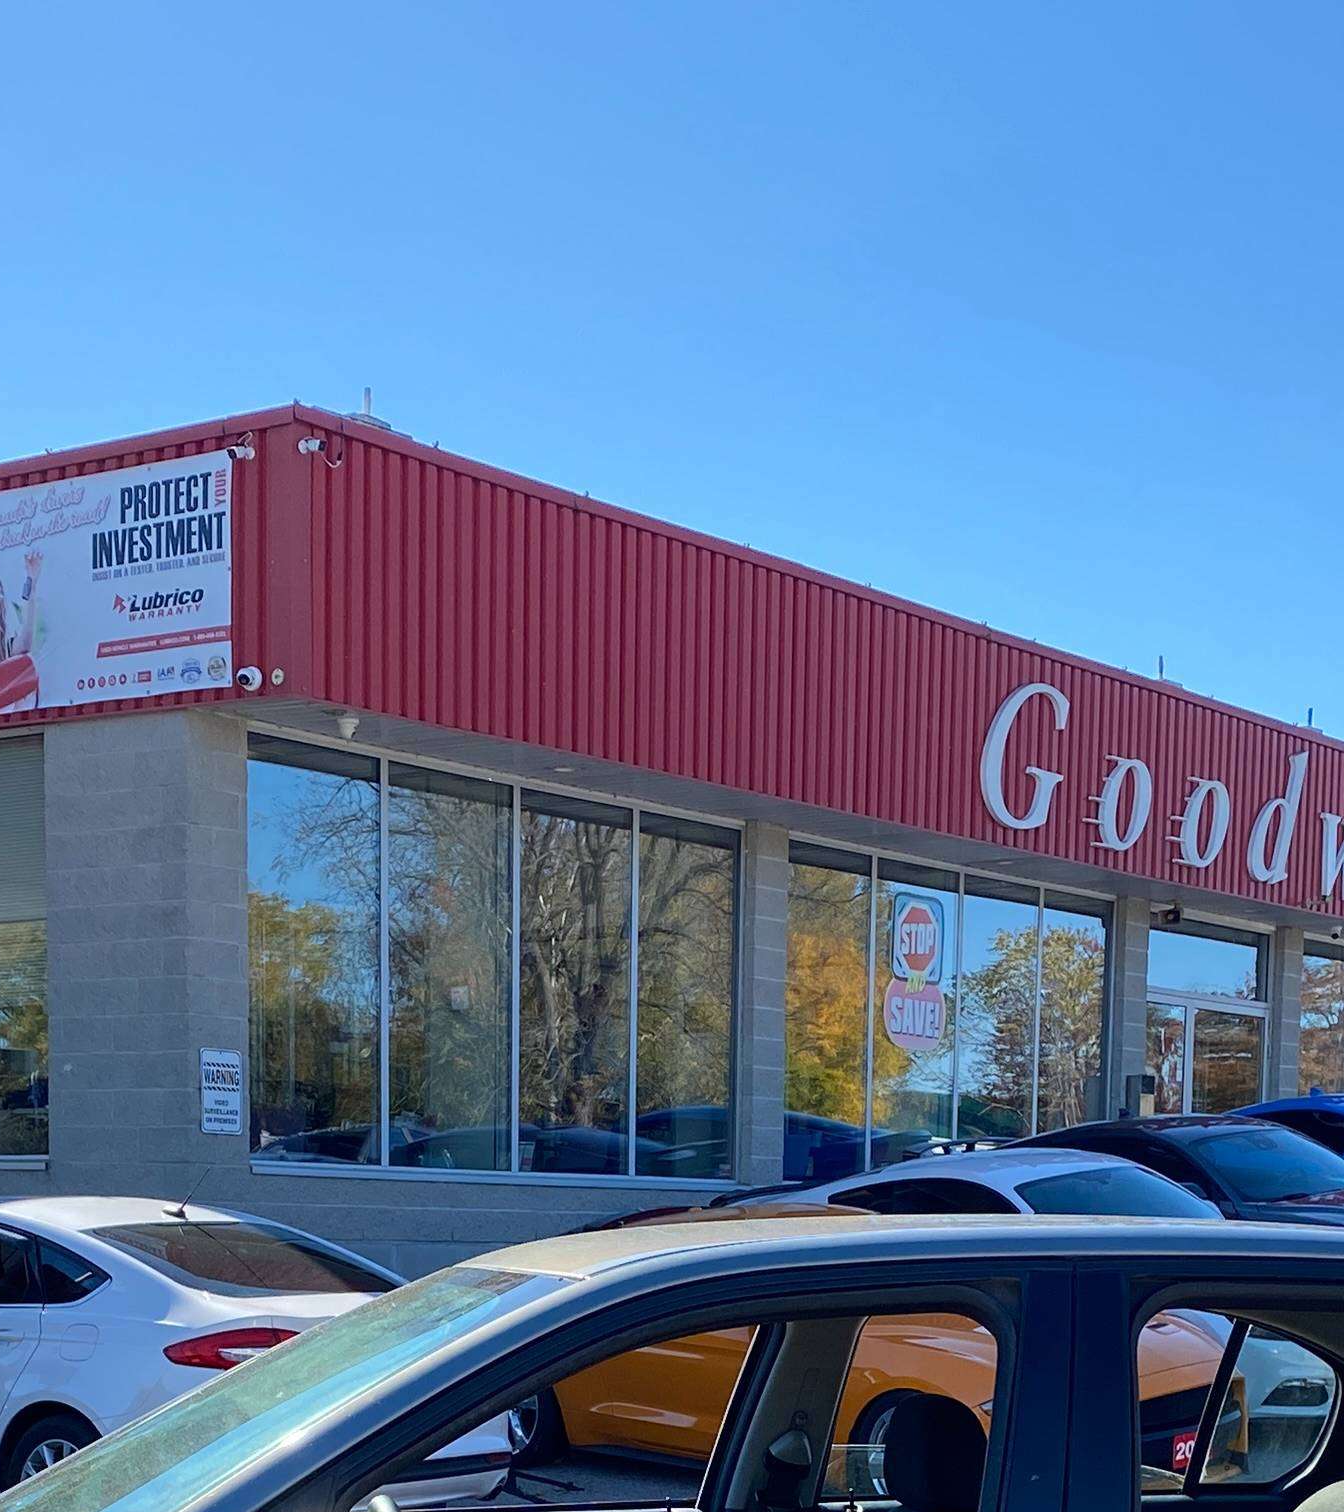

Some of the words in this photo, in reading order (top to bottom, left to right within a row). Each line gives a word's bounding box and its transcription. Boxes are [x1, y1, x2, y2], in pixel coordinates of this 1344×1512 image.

[120, 472, 212, 524] PROTECT
[214, 468, 226, 507] YOUR
[92, 511, 226, 569] INVESTMENT
[128, 603, 202, 621] WARRANTY
[129, 588, 205, 612] Lubrico
[901, 922, 936, 956] STOP
[889, 996, 940, 1040] SAVE!
[203, 1068, 240, 1087] WARNING
